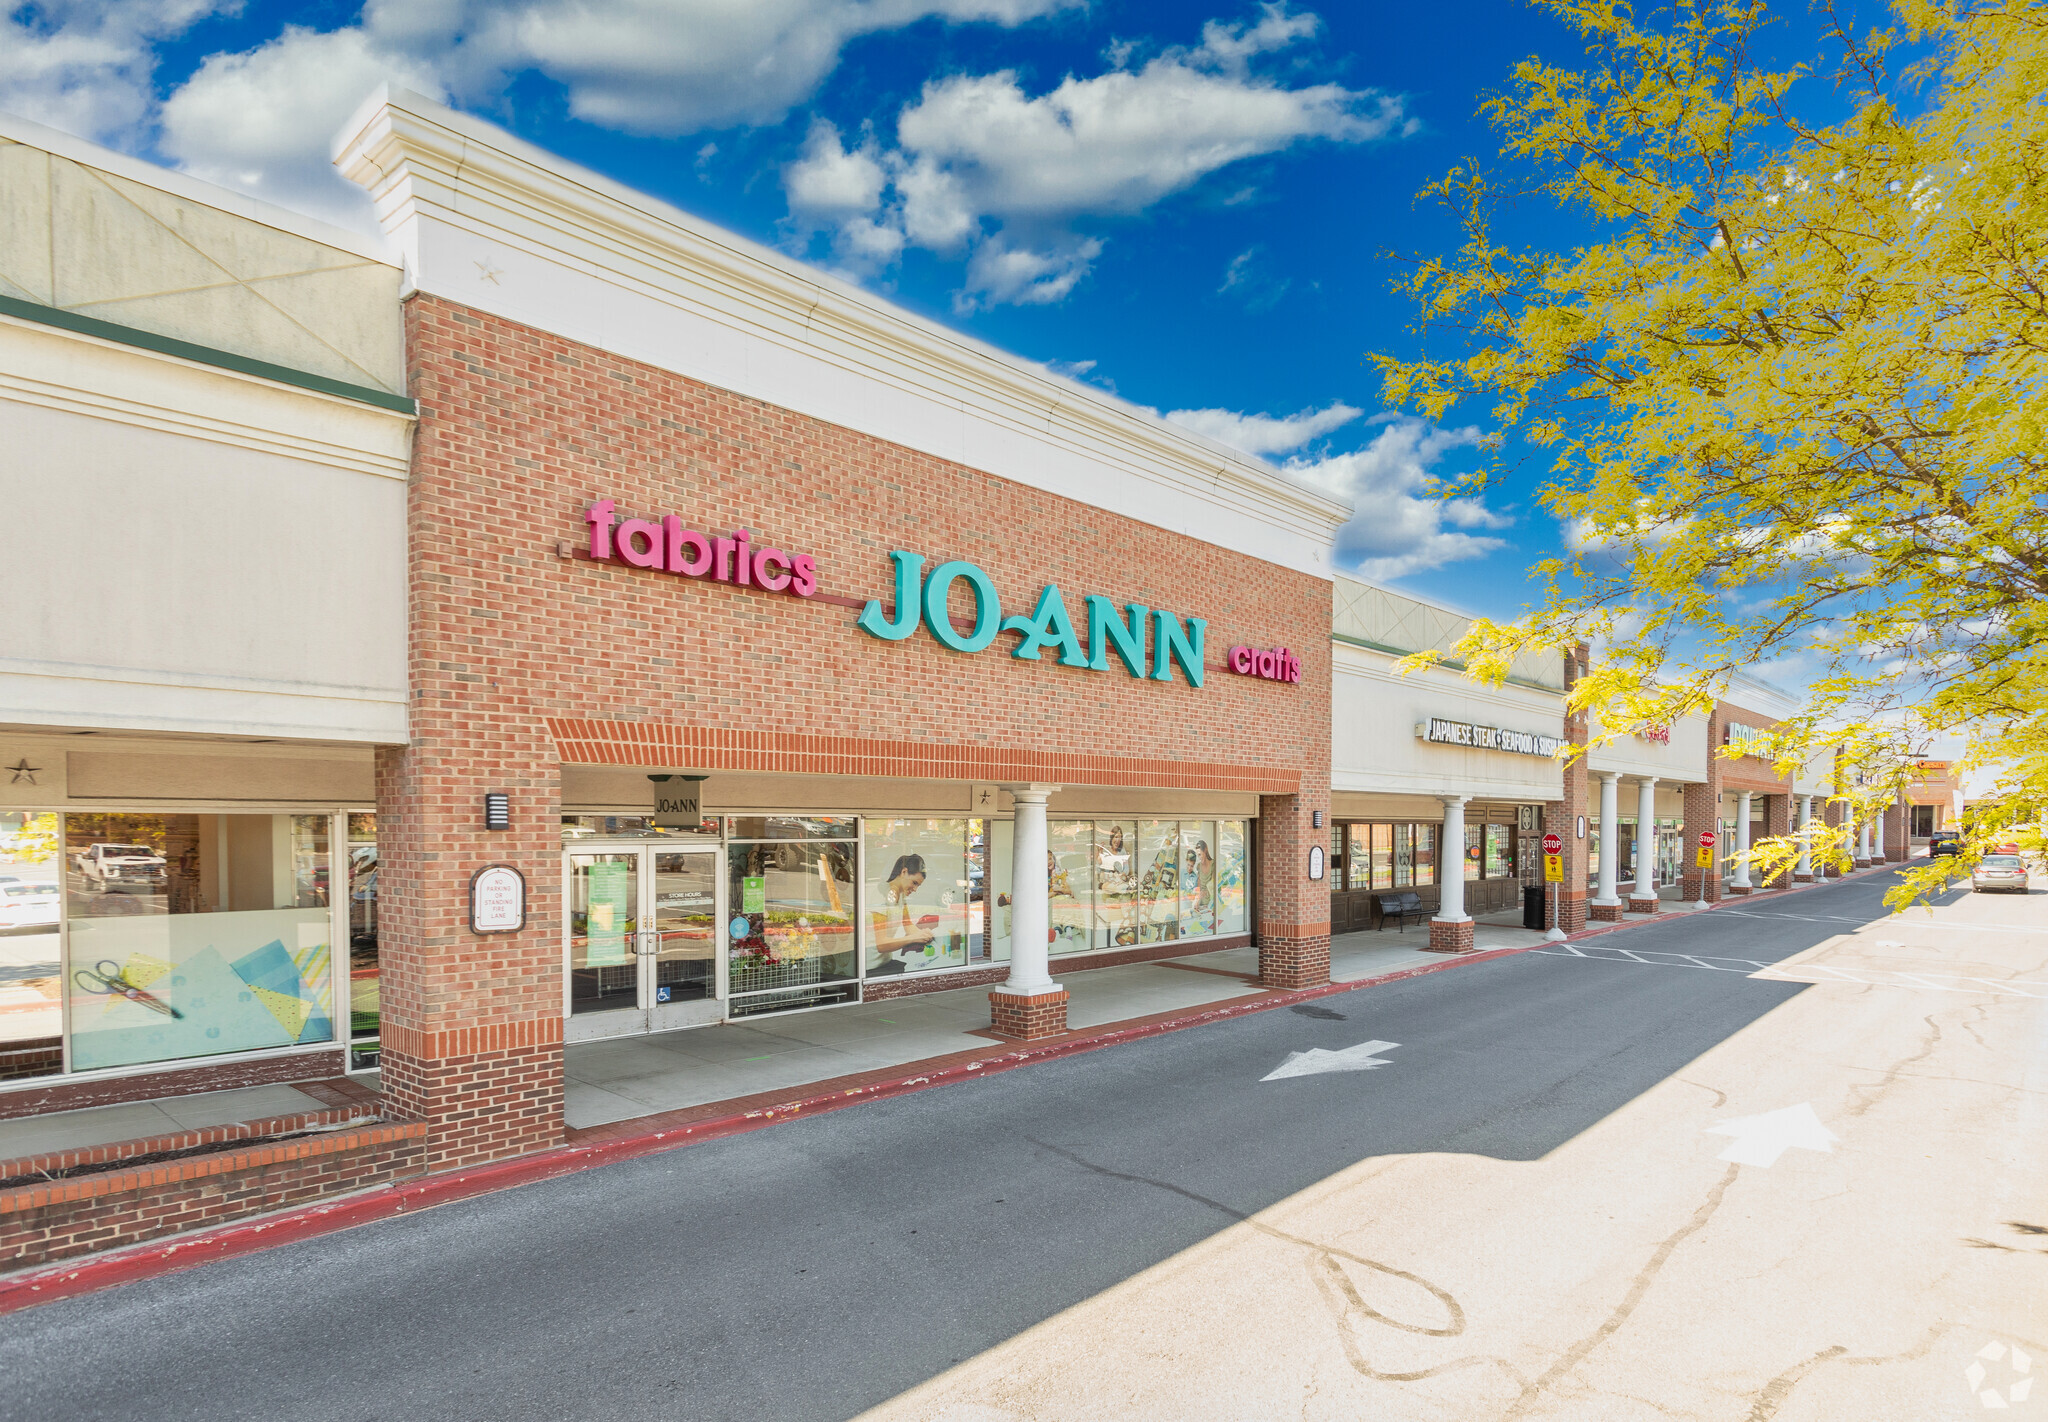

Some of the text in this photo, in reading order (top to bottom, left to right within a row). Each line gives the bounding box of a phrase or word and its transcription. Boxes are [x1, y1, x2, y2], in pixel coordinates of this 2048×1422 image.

[585, 500, 817, 597] fabrics
[1228, 645, 1301, 685] crafts
[1431, 719, 1472, 745] JAPANESE
[1473, 725, 1498, 748] STEAK
[1501, 730, 1533, 753] SEAFOOD
[1533, 736, 1539, 754] &
[1543, 840, 1561, 849] STOP
[1700, 835, 1715, 844] STOP
